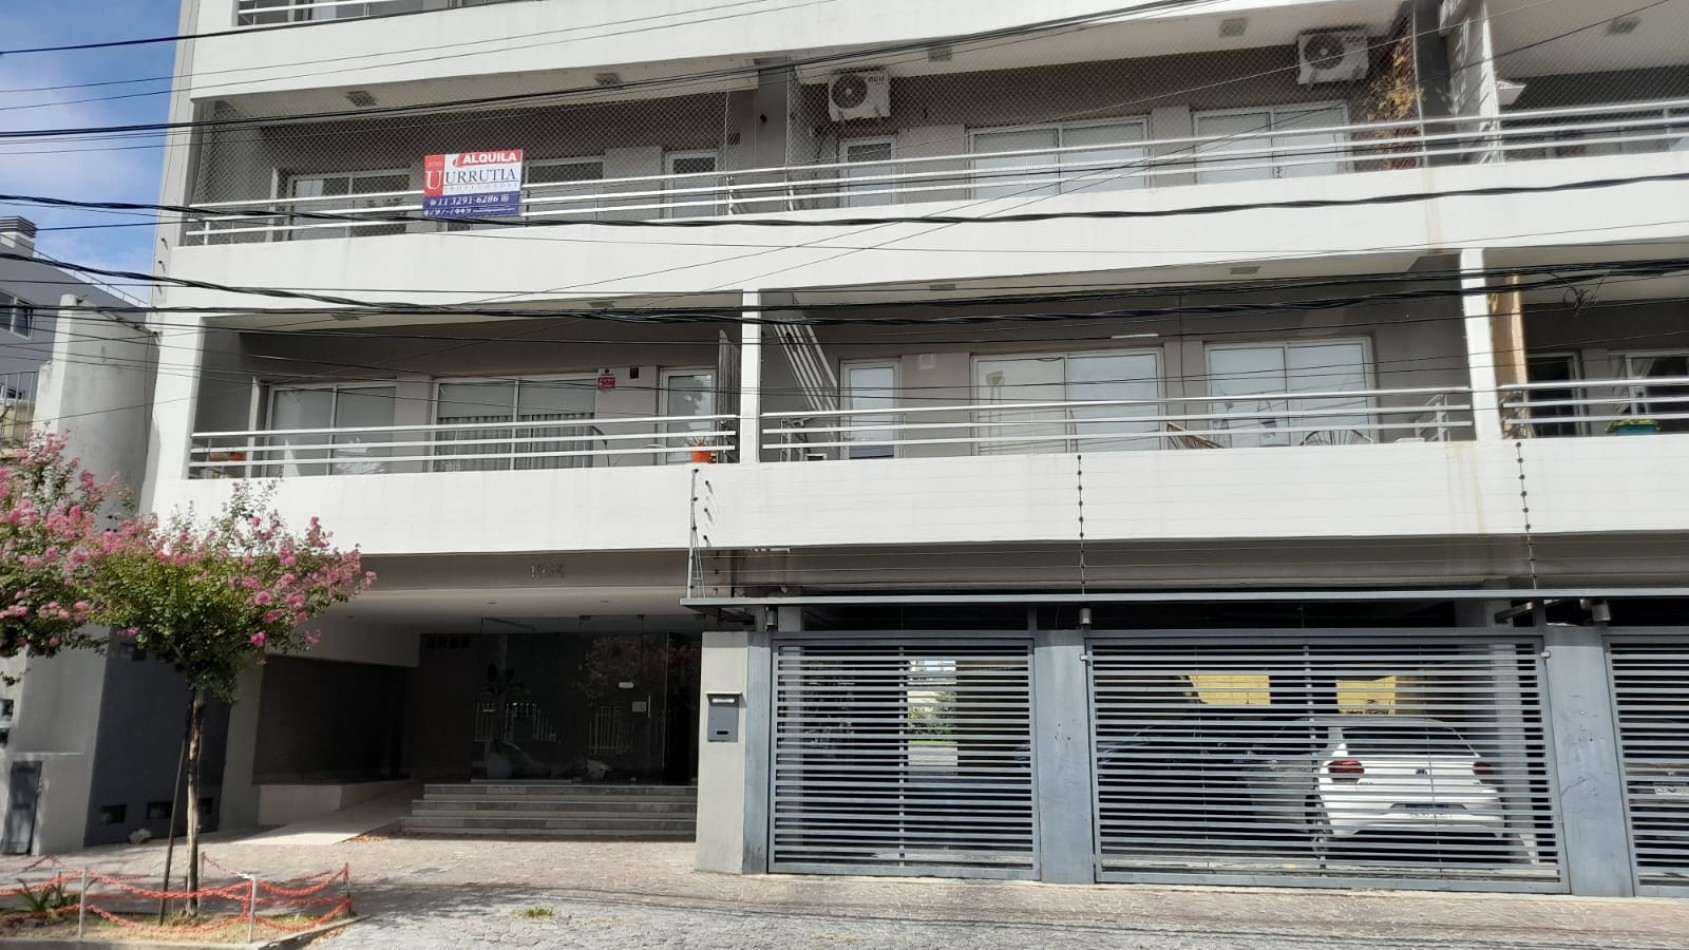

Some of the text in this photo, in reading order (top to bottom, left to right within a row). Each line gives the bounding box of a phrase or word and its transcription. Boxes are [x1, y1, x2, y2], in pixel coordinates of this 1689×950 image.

[463, 152, 517, 164] ALQUILA
[425, 170, 442, 190] U
[445, 168, 516, 184] URRUTIA
